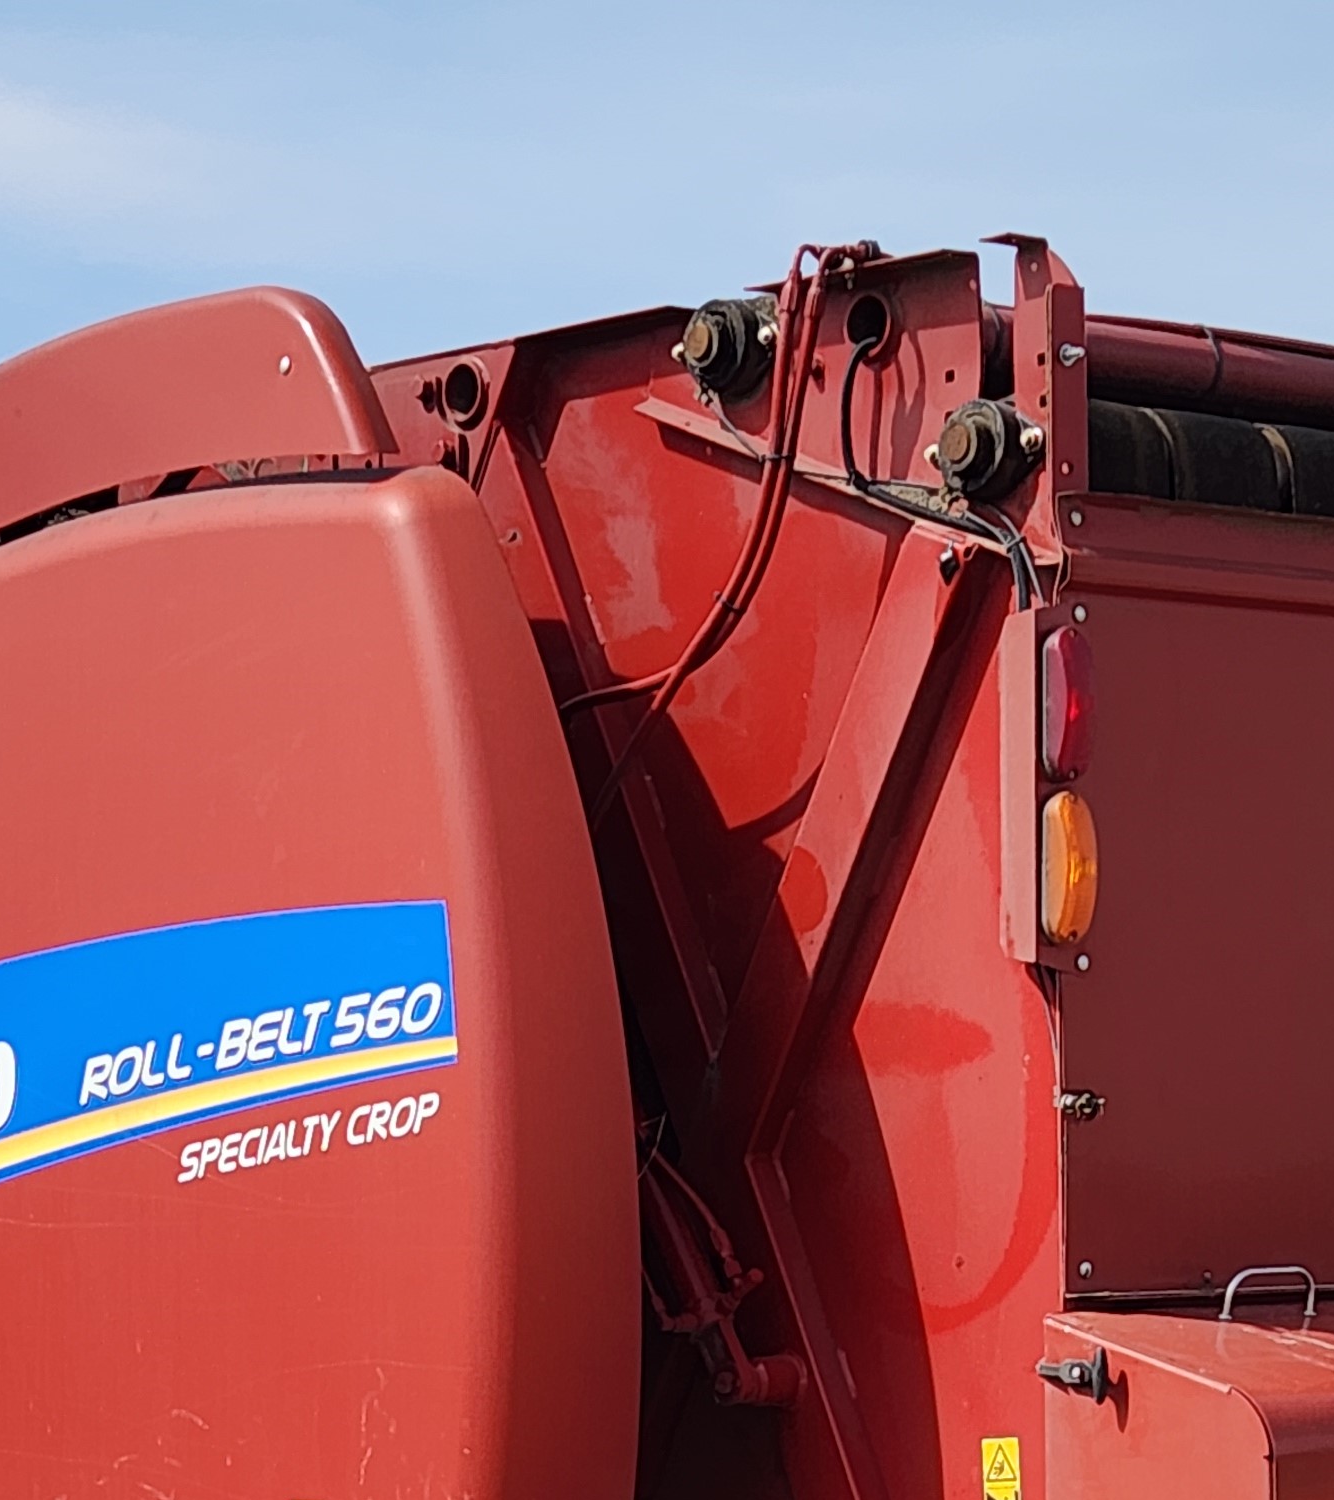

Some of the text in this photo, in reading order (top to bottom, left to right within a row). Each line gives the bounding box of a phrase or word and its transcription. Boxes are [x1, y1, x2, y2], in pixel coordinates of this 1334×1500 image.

[78, 981, 443, 1107] ROLL-BELT 560
[177, 1090, 440, 1184] SPECIALTY CROP
